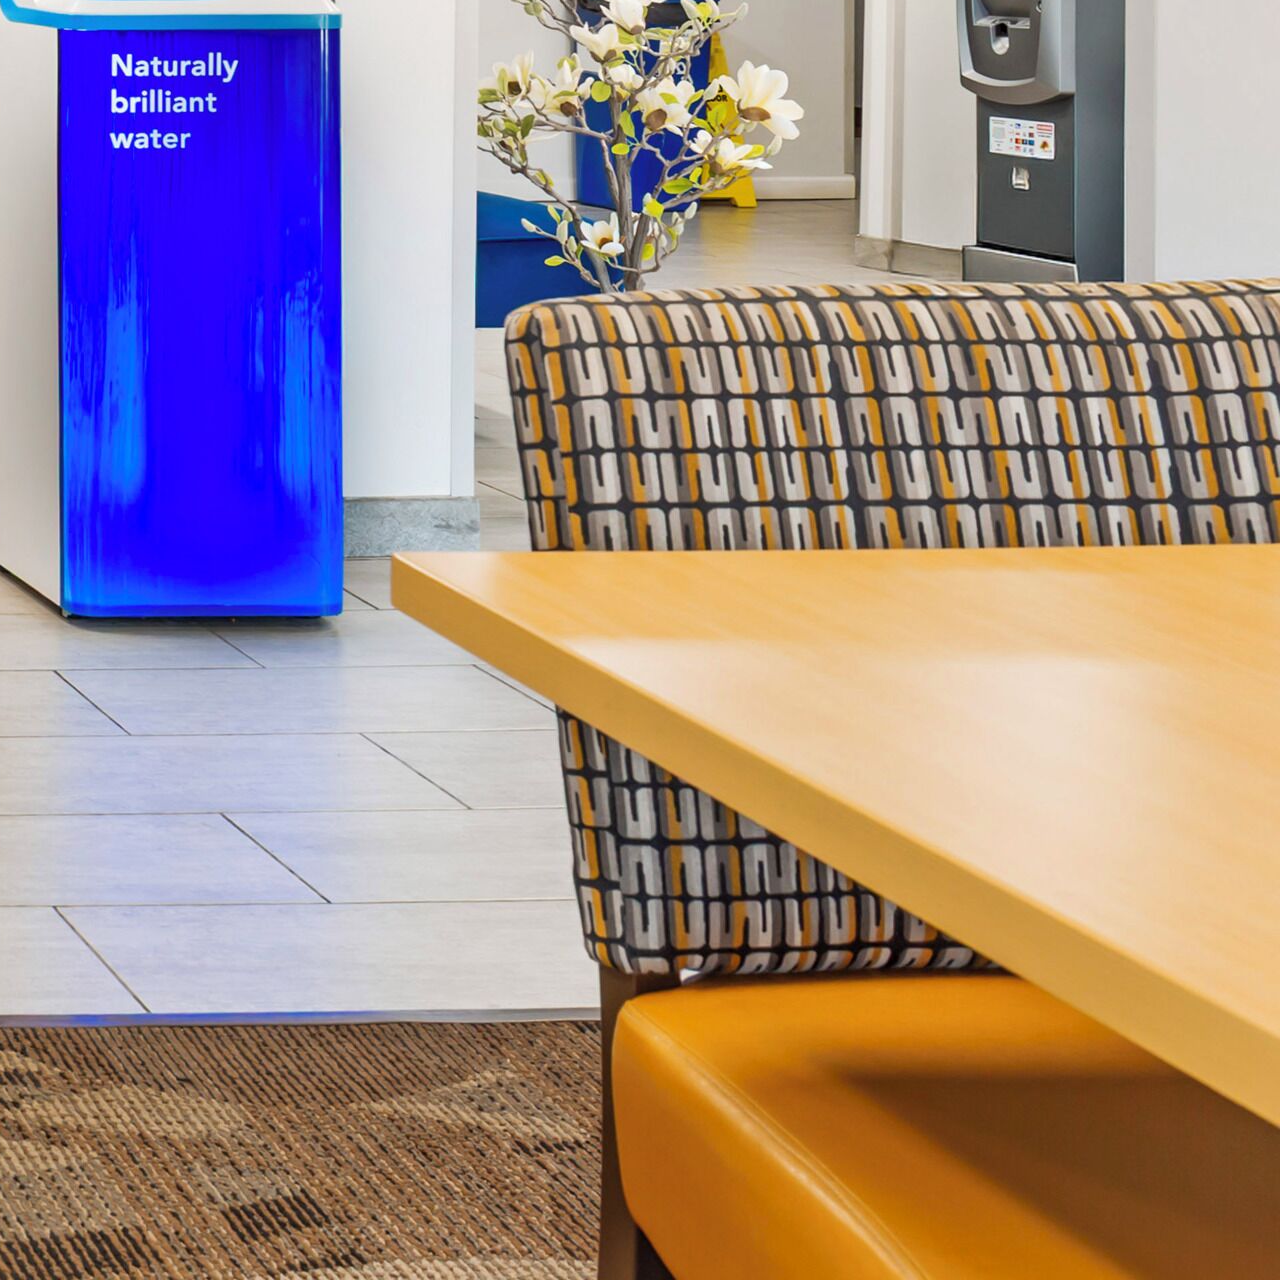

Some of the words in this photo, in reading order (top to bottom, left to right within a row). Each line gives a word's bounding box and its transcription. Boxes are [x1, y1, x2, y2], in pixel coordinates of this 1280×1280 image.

[110, 52, 239, 83] Naturally
[110, 88, 217, 114] brilliant
[109, 129, 191, 150] water
